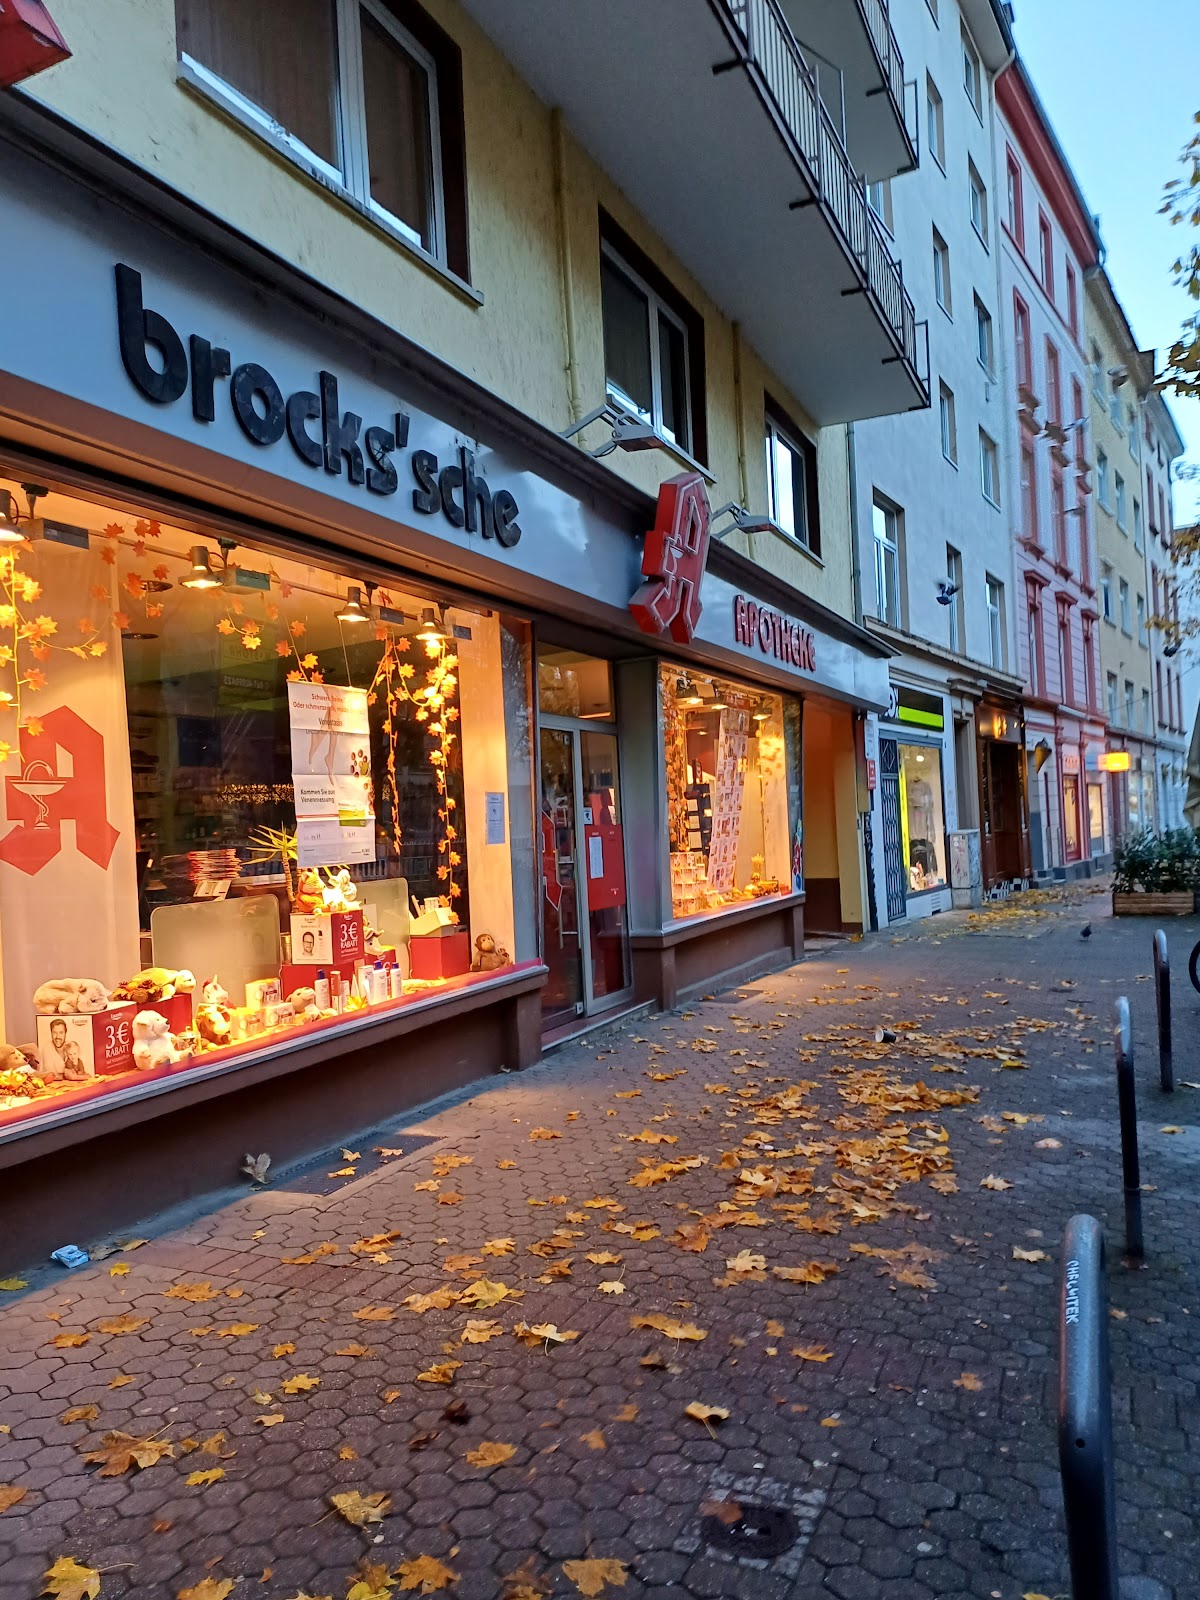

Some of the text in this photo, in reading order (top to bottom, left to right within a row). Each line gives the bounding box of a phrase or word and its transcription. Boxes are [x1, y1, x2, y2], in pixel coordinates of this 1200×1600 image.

[115, 263, 522, 548] brocks'sche
[734, 594, 816, 673] APOTHEKE
[292, 701, 305, 709] Oder
[300, 788, 320, 796] Kommen
[320, 788, 328, 796] Sie
[340, 939, 358, 949] RABATT
[105, 1044, 130, 1059] RABATT
